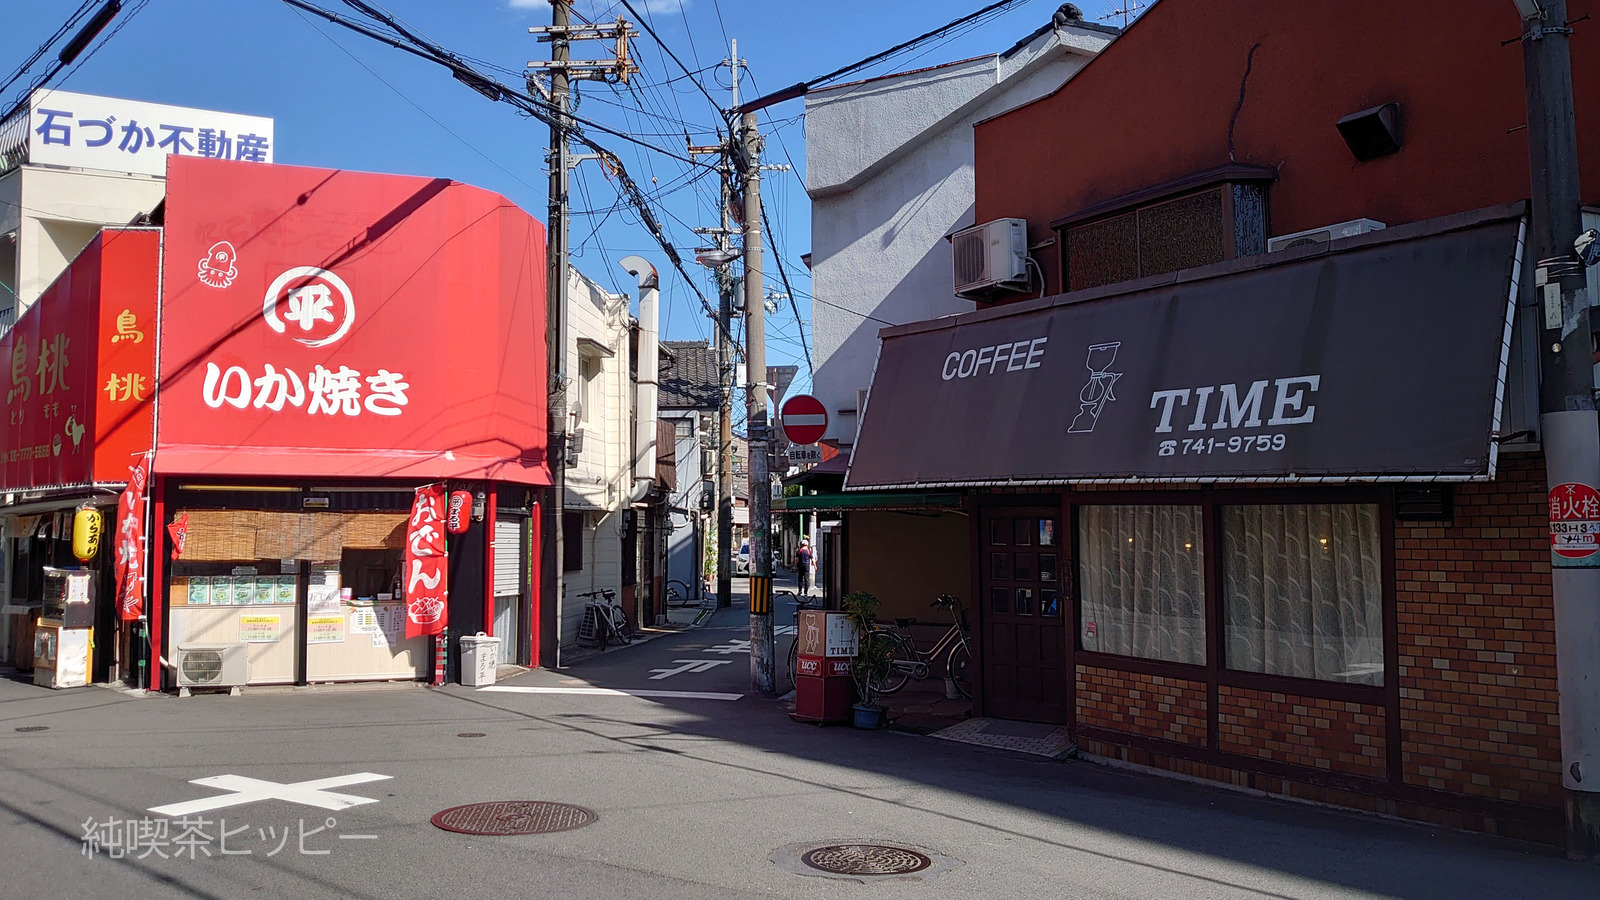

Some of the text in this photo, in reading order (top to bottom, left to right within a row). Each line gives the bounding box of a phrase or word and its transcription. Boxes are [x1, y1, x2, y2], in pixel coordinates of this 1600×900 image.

[35, 108, 270, 163] 石づか不動産
[7, 333, 71, 404] 鳥桃
[103, 309, 147, 402] 鳥桃
[942, 337, 1048, 381] COFFEE
[202, 362, 410, 416] いか焼き
[1149, 375, 1321, 433] TIME
[11, 411, 25, 425] とり
[789, 450, 821, 461] 自転車を除く
[1181, 433, 1286, 455] 741-9759
[1549, 495, 1600, 520] 消火栓
[86, 513, 100, 556] からあげ
[409, 493, 441, 594] おでん
[801, 660, 818, 671] UCC
[830, 646, 855, 655] TIME
